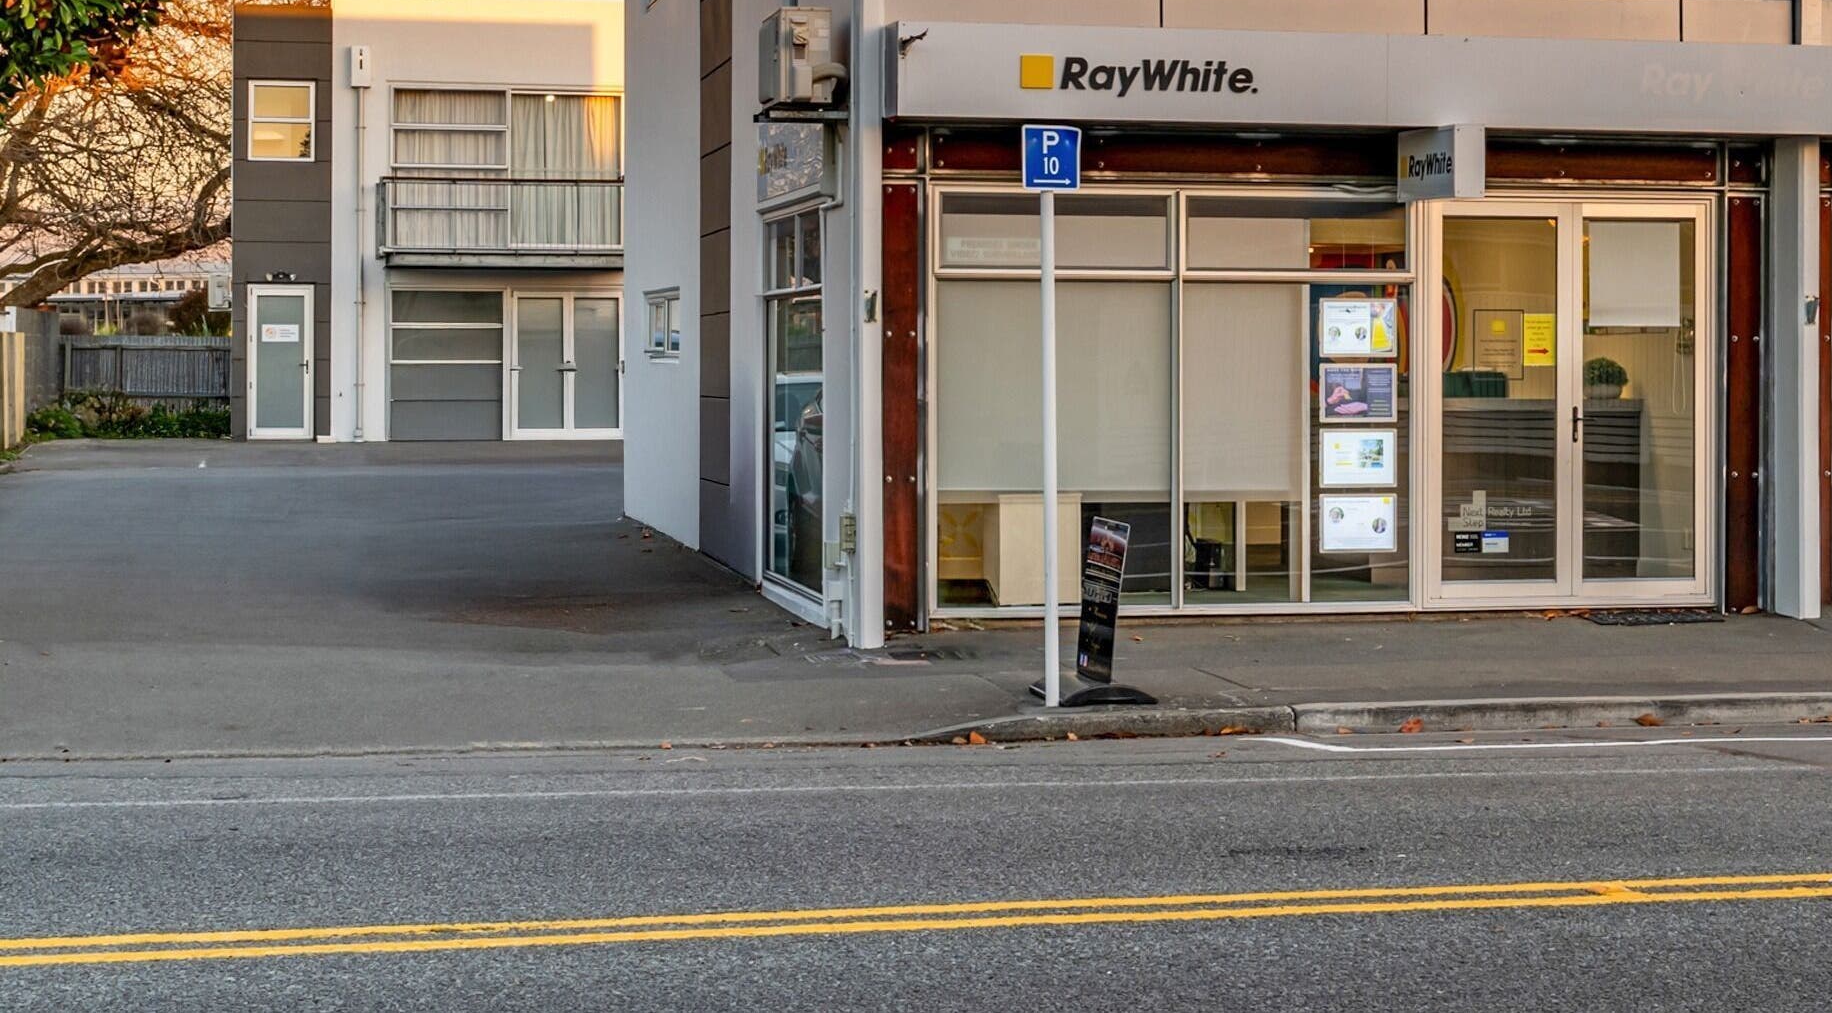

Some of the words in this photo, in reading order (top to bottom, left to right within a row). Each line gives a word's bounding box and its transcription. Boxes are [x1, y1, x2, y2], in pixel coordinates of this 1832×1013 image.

[1042, 131, 1060, 154] P
[1044, 157, 1060, 175] 10
[1408, 152, 1453, 181] RayWhite
[1462, 506, 1484, 517] Next
[1487, 506, 1514, 518] Realty
[1517, 506, 1532, 517] Ltd
